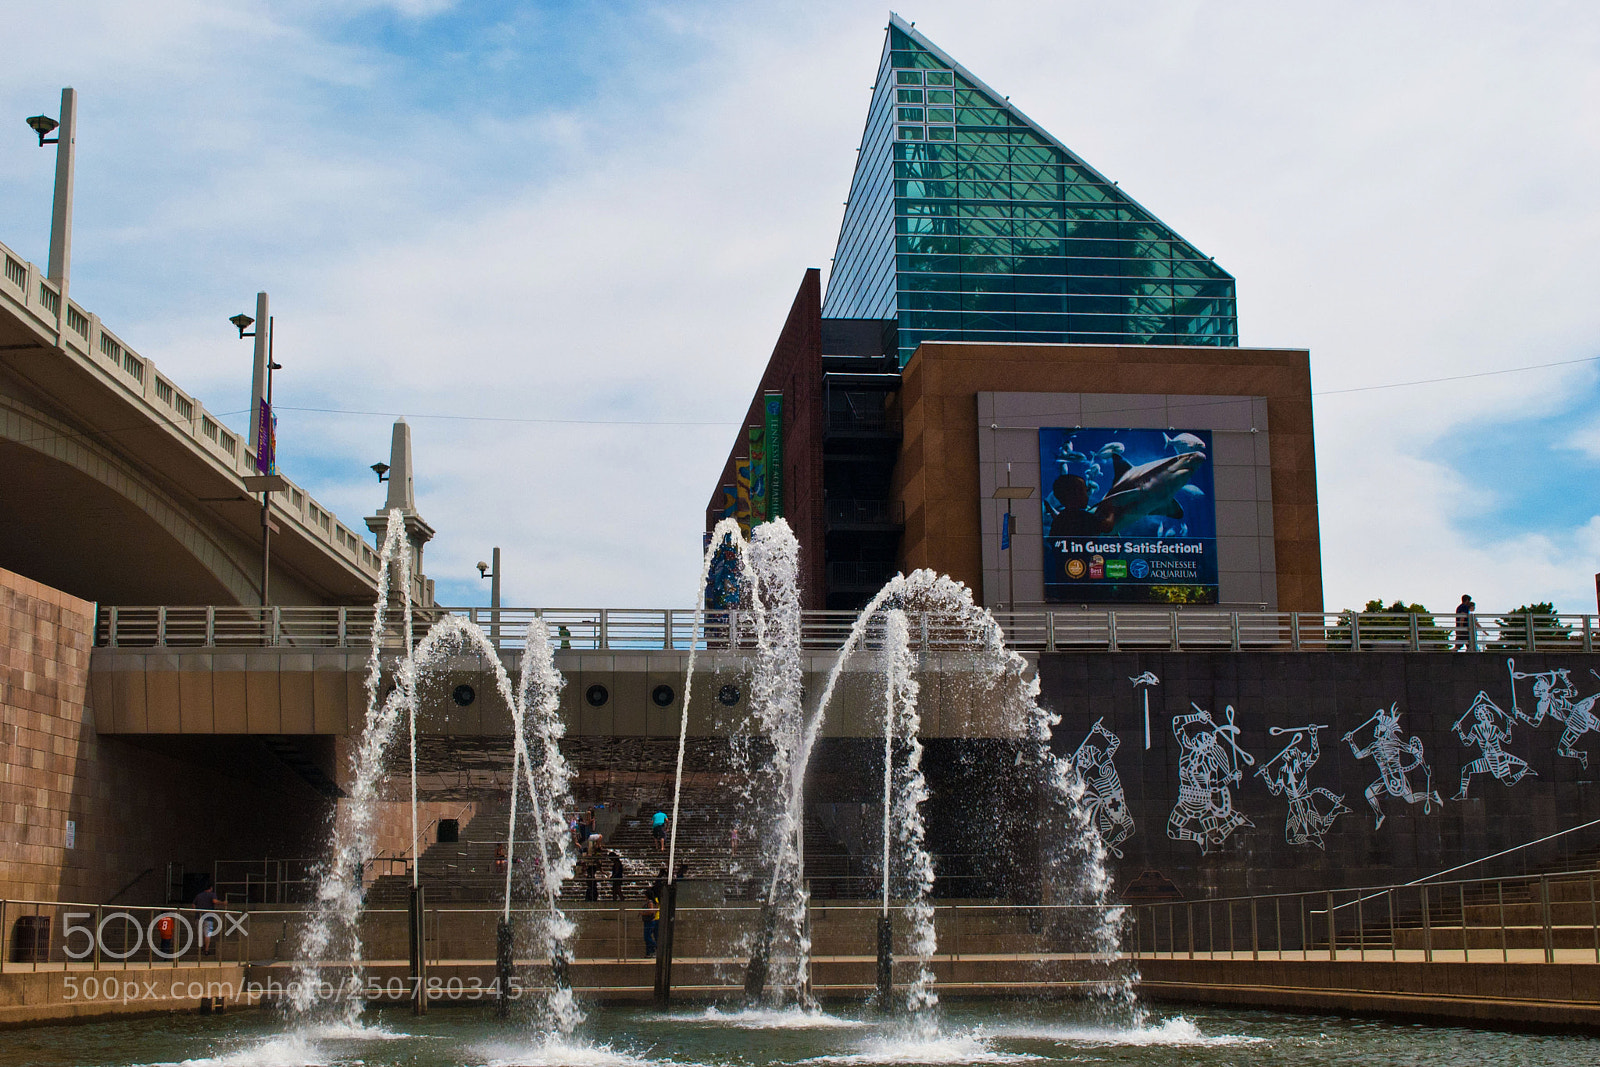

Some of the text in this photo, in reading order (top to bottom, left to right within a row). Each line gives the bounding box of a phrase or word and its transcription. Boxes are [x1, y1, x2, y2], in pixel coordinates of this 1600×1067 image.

[771, 419, 780, 517] TENNESSEE AQUARIU
[1055, 541, 1203, 554] #1 in Guest Satisfaction!
[1150, 561, 1197, 569] TENNESSEE
[1150, 570, 1198, 579] AQUARIUM
[161, 920, 168, 931] 8
